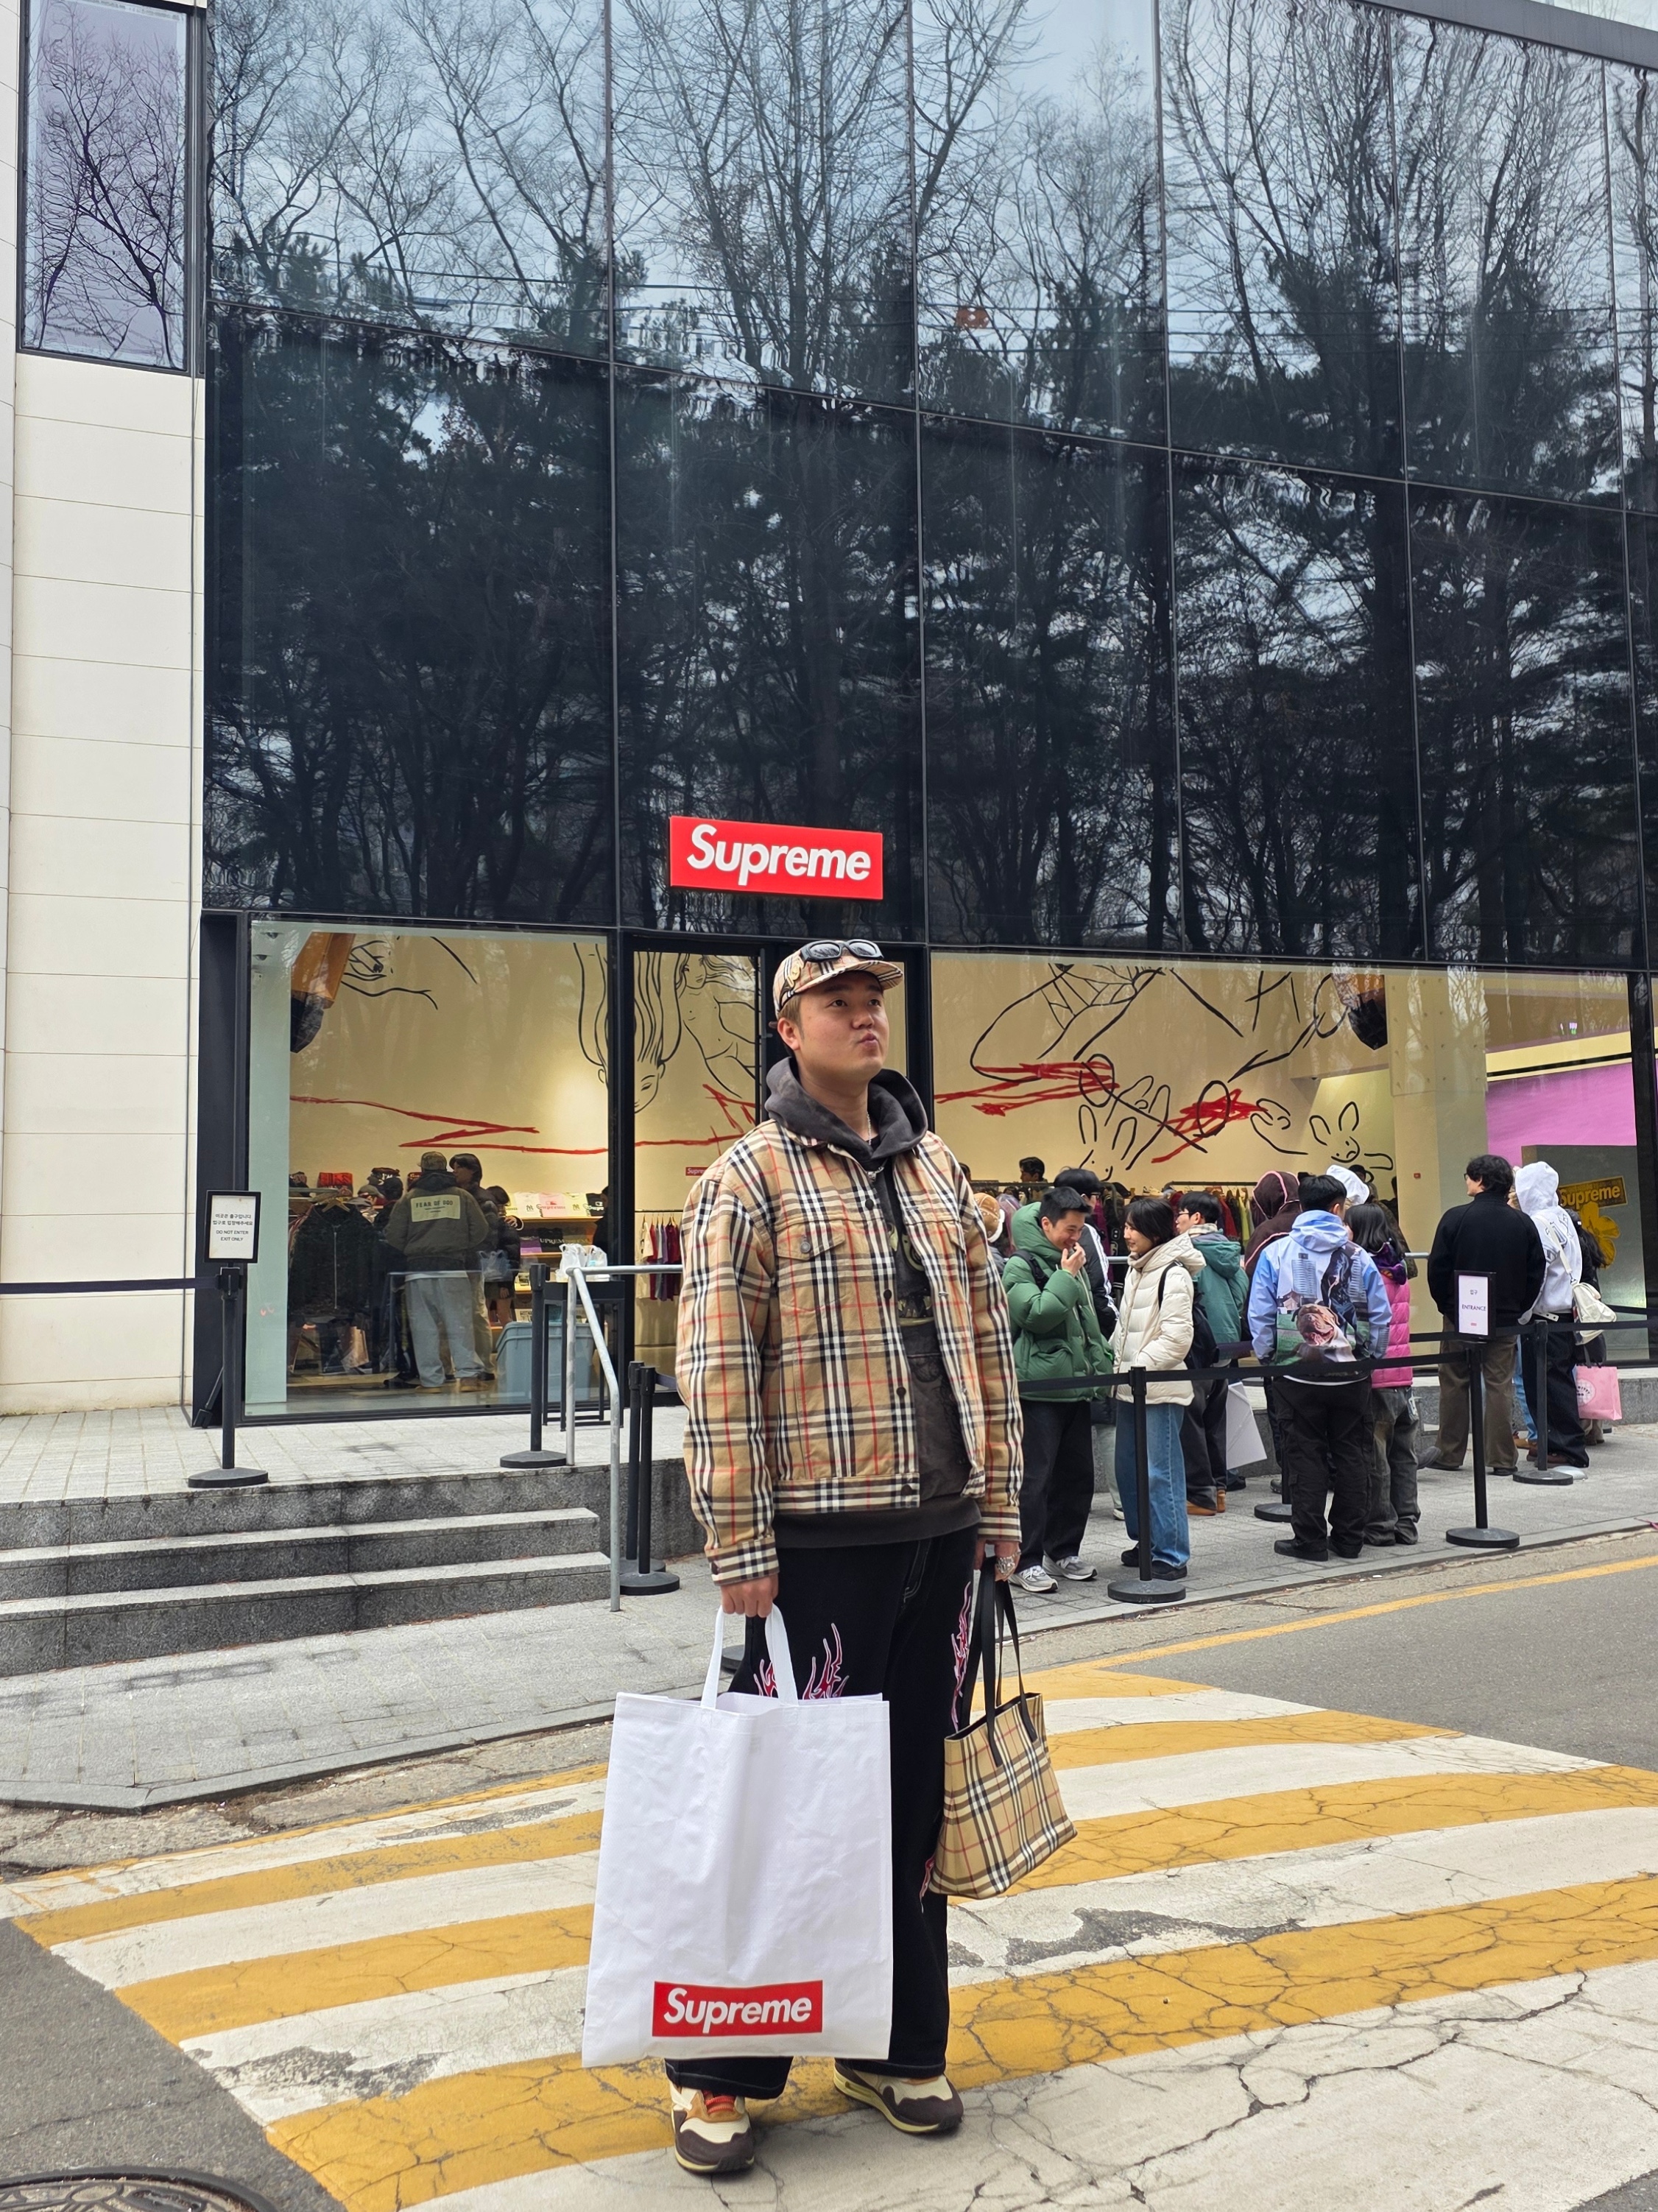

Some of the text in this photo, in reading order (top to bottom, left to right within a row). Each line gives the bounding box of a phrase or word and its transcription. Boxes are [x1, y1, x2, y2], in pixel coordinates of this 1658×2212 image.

[686, 823, 871, 887] Supreme
[1559, 1186, 1620, 1210] Supreme
[1461, 1303, 1486, 1311] ENTRANCE
[663, 1987, 812, 2034] Supreme
